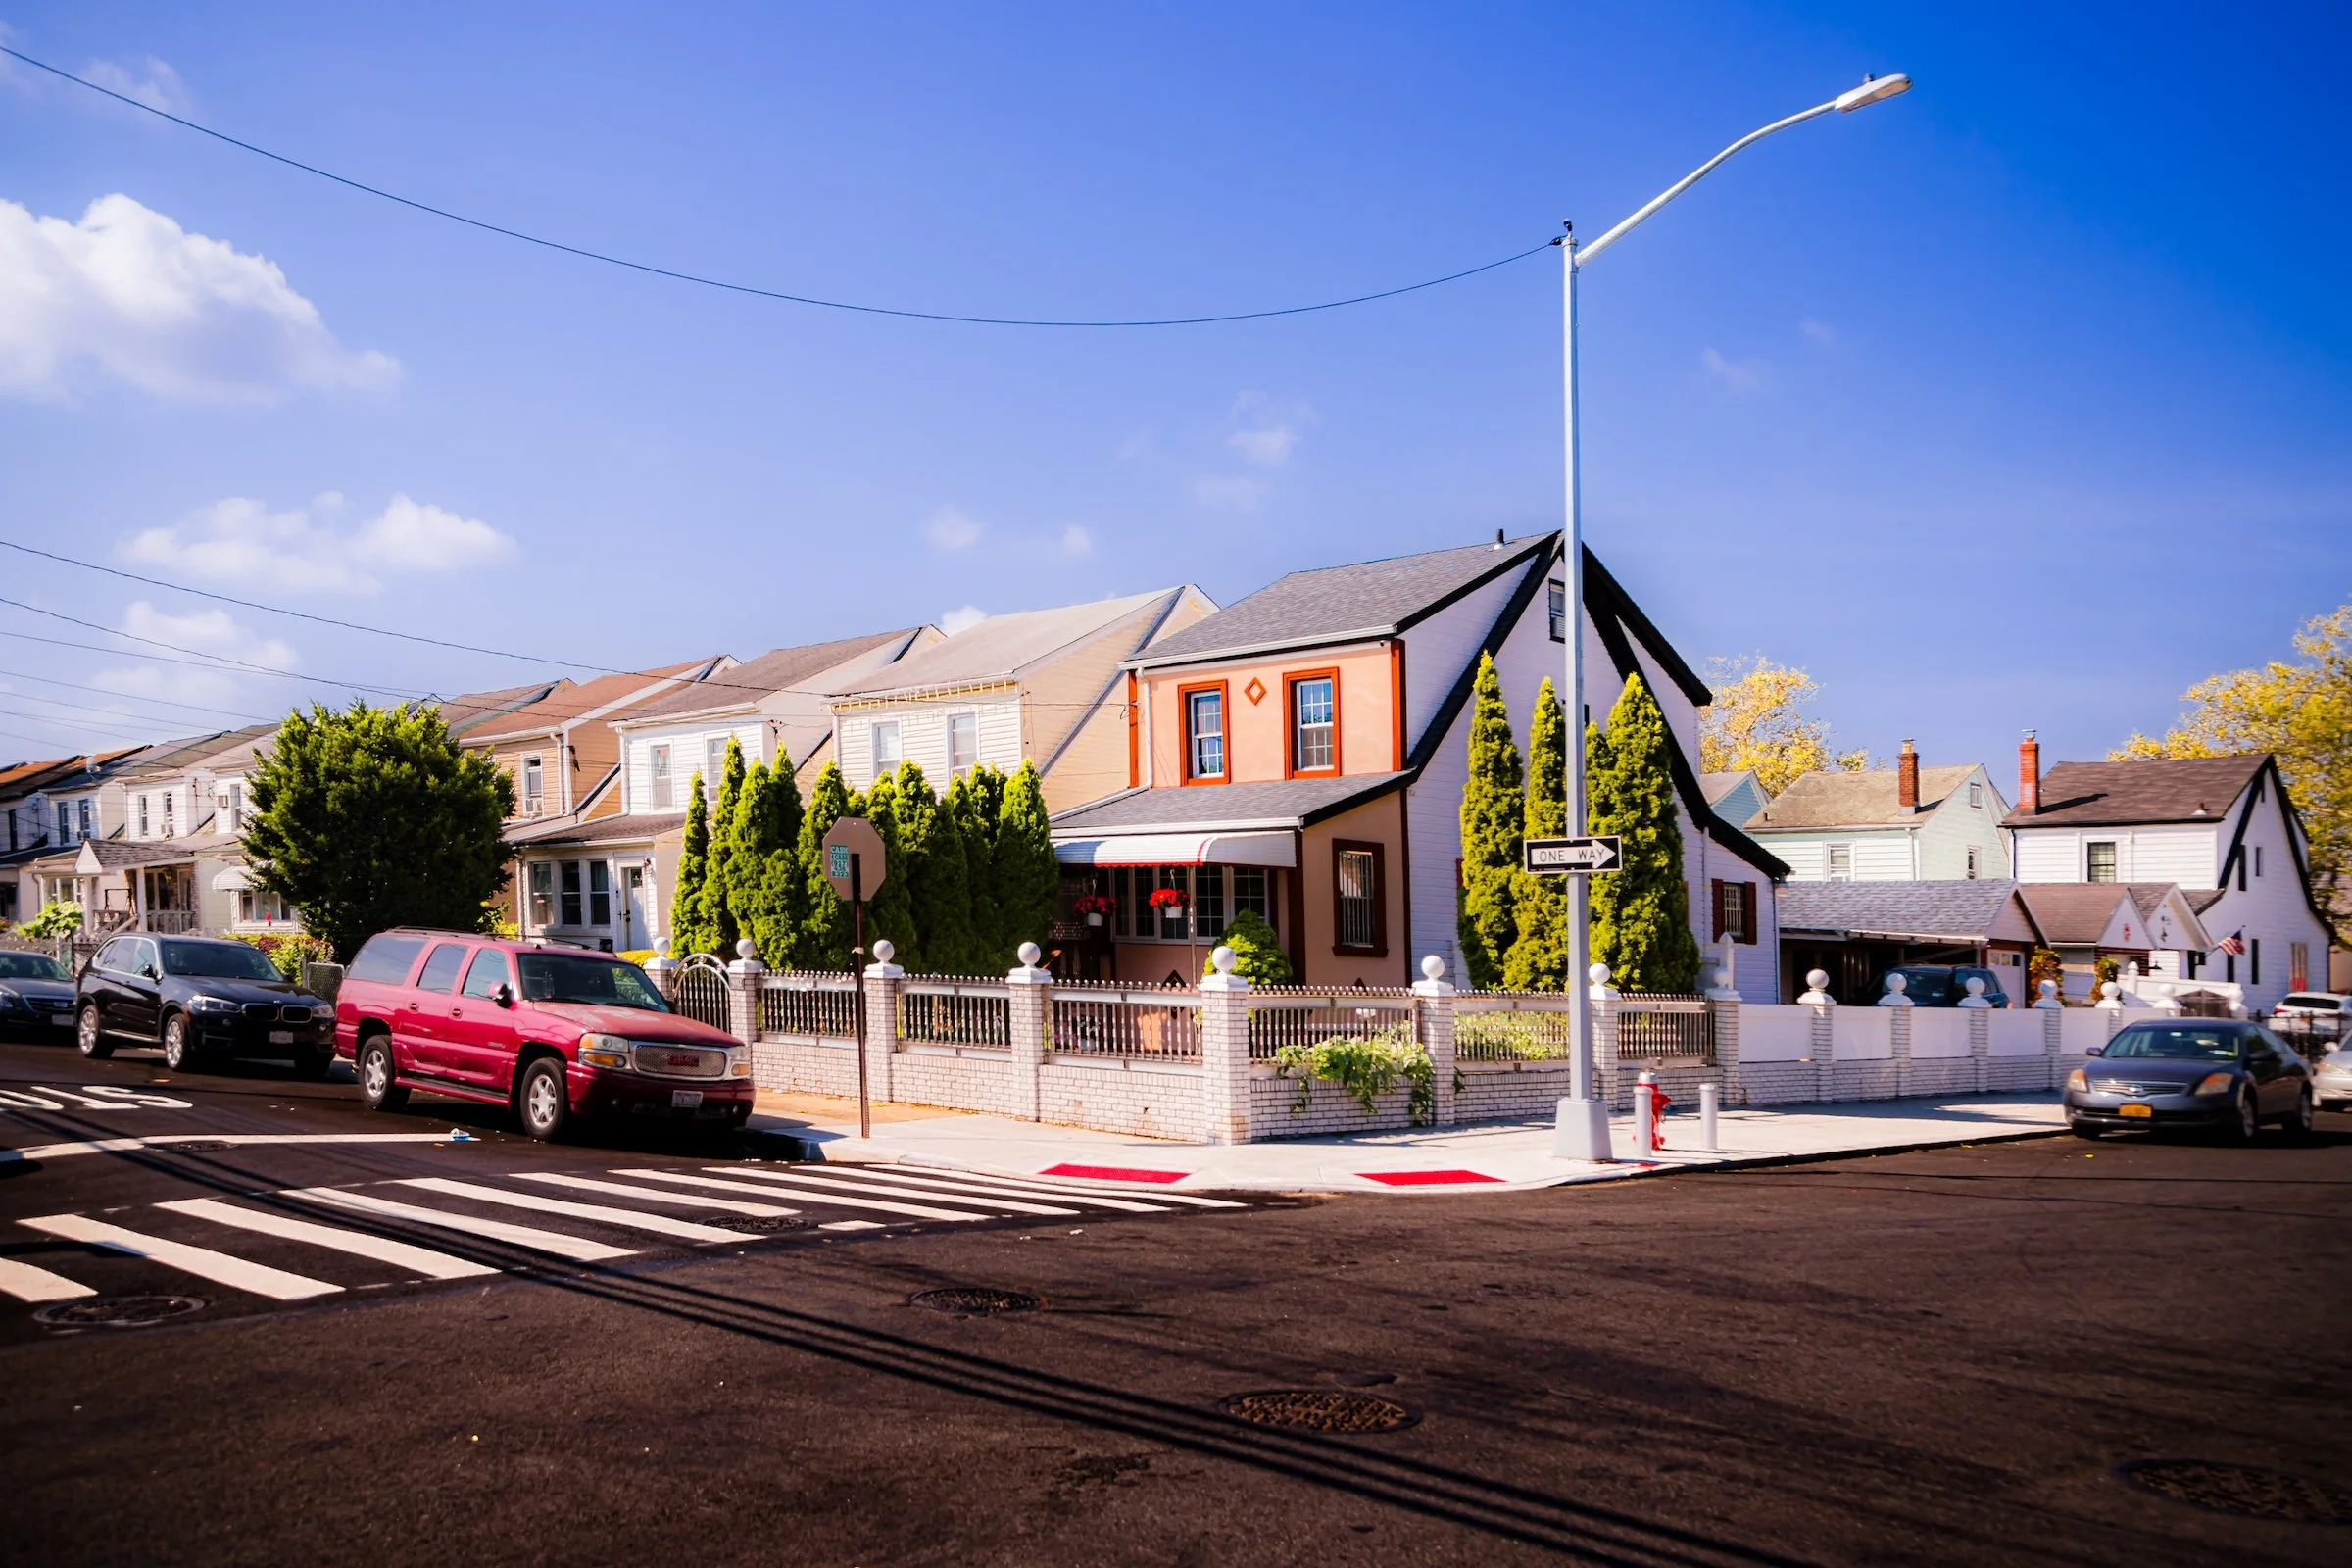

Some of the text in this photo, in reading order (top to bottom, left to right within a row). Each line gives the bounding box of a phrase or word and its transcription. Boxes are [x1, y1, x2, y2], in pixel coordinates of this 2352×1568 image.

[1540, 849, 1605, 862] ONE WAY
[0, 1086, 194, 1113] STO
